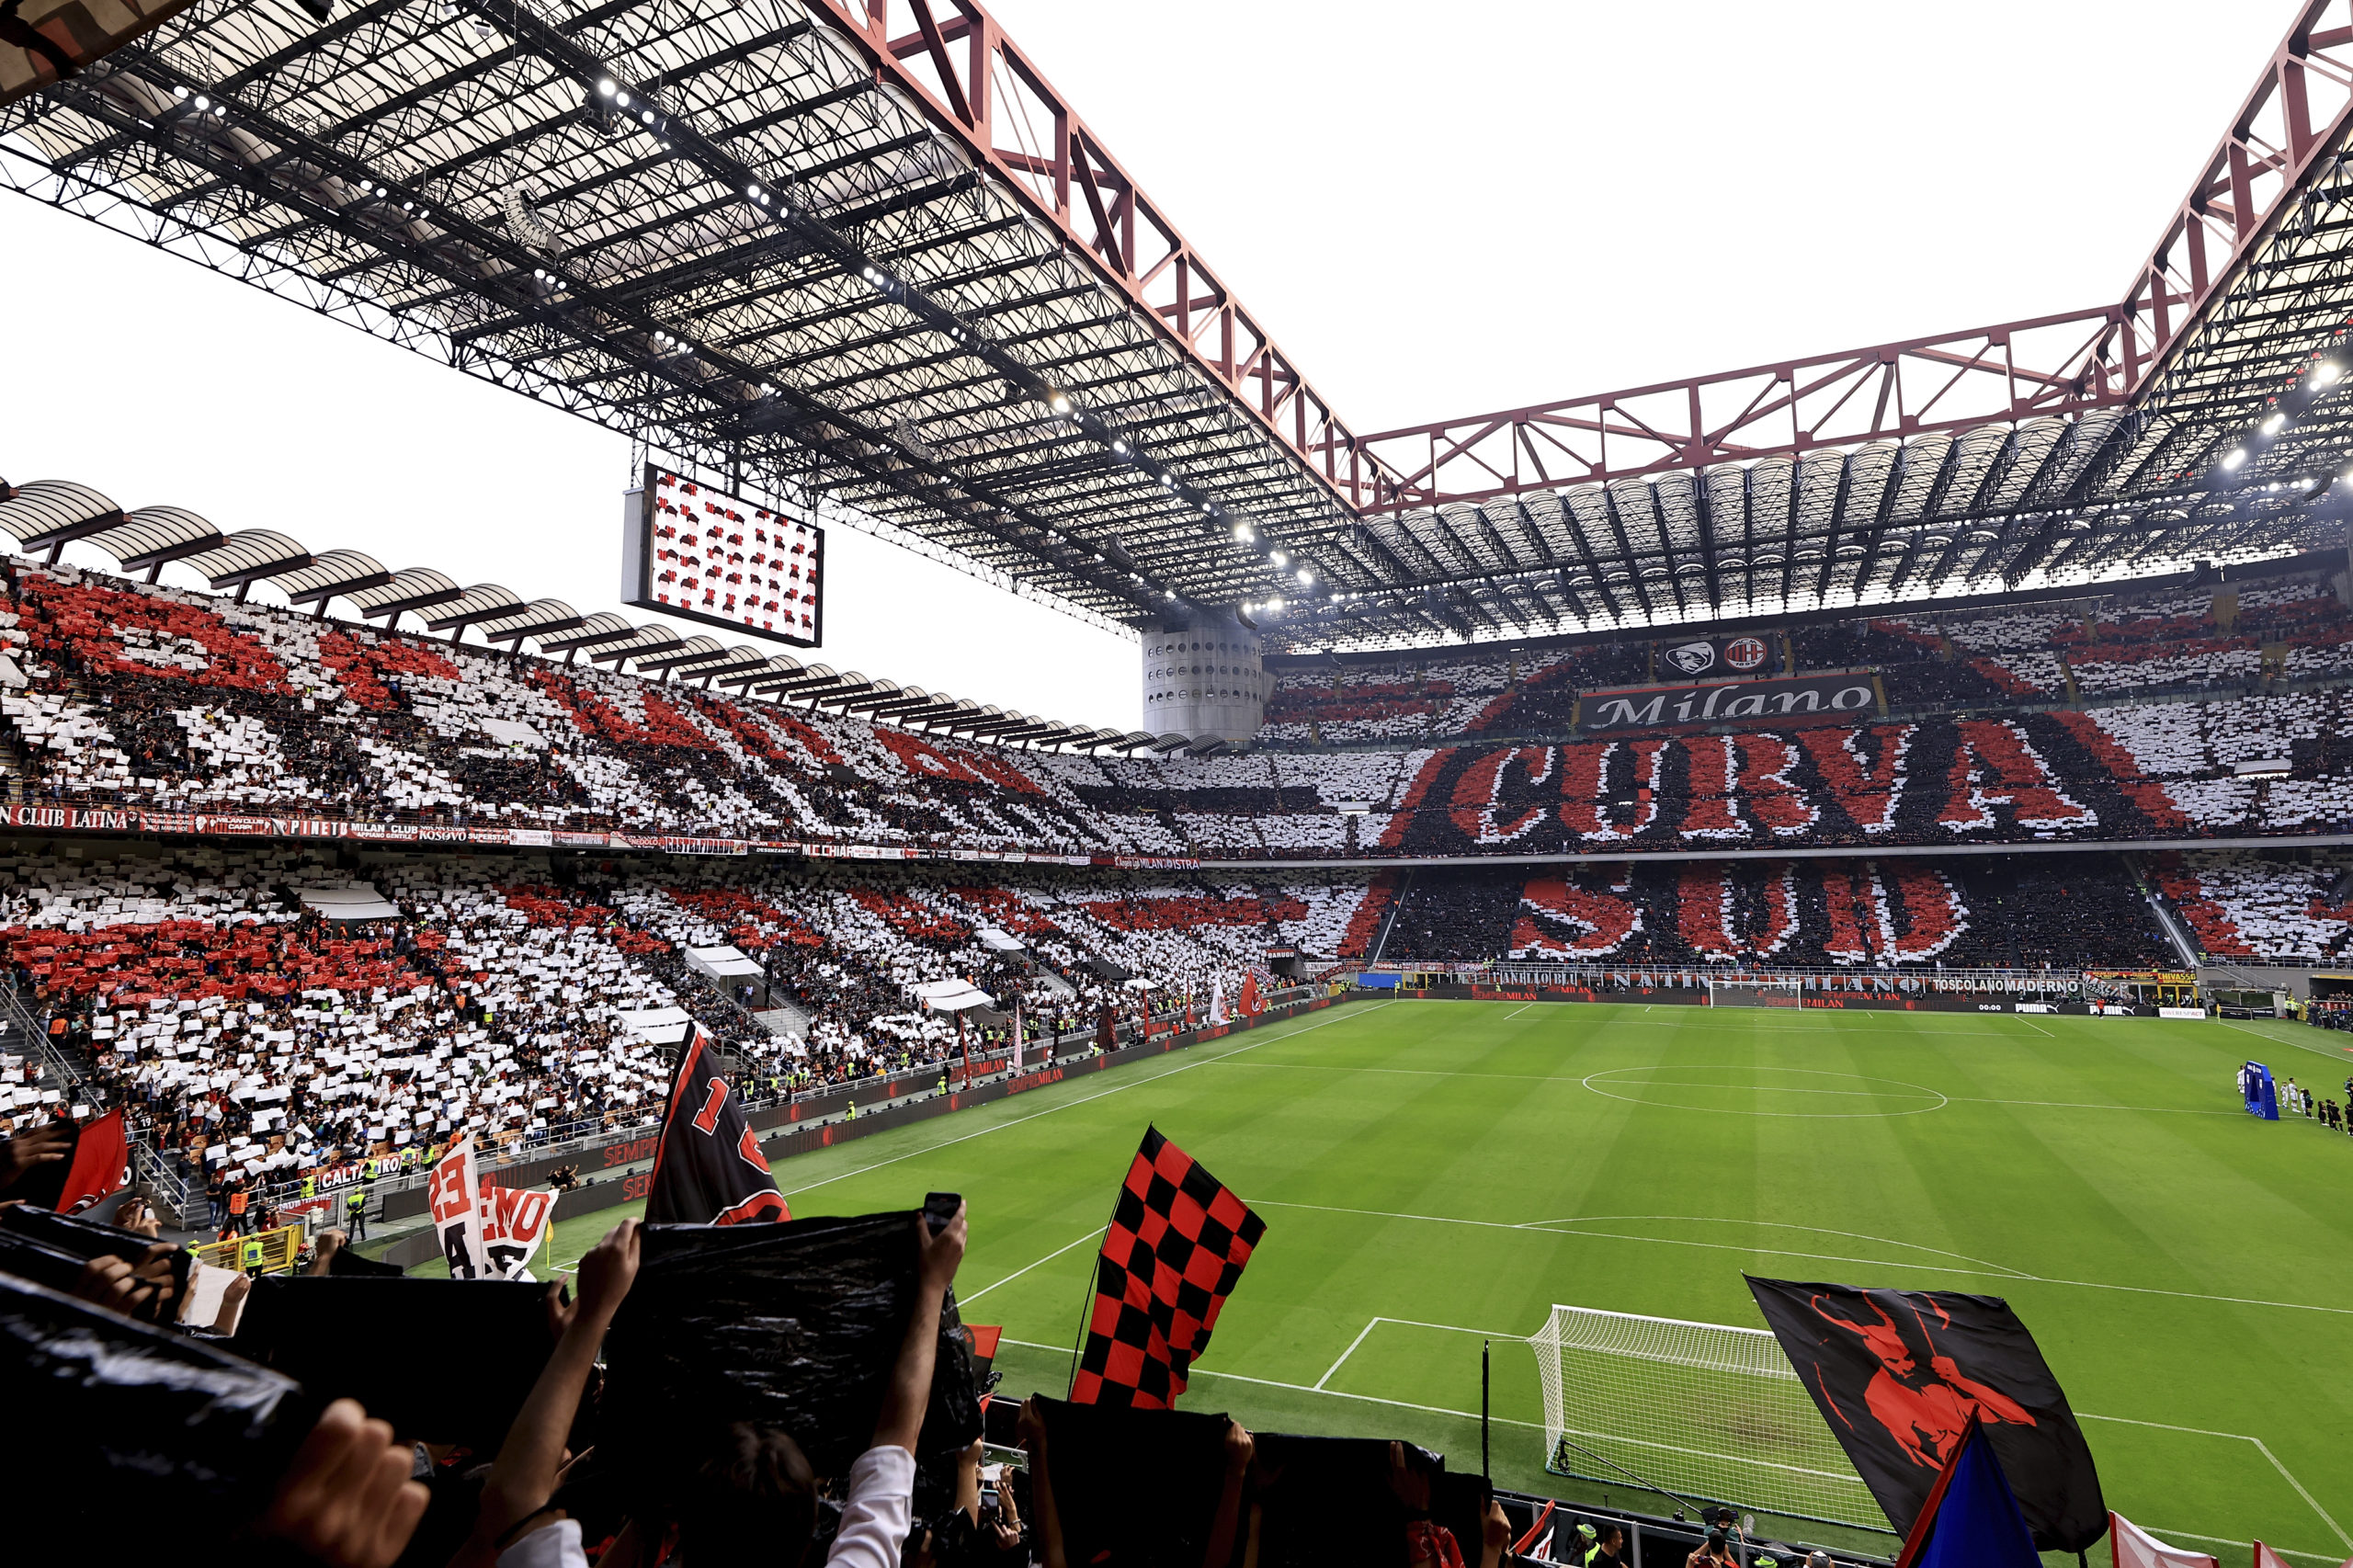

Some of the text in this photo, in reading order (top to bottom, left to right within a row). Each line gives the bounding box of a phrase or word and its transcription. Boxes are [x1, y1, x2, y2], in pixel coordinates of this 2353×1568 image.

[1590, 686, 1871, 729] Milano
[1450, 719, 2098, 844] CURVA
[17, 808, 64, 826] CLUB
[71, 810, 128, 828] LATINA
[351, 823, 418, 835] MILAN CLUB
[418, 830, 466, 842] KOSOVO
[468, 833, 510, 841] SUPERSTAR
[1140, 858, 1199, 869] MILAN ISTRA
[1508, 860, 1971, 967] SUD
[1553, 971, 1577, 985] BLU
[2016, 1003, 2048, 1013] PUMA
[1007, 1067, 1063, 1096] SEMPREMILAN
